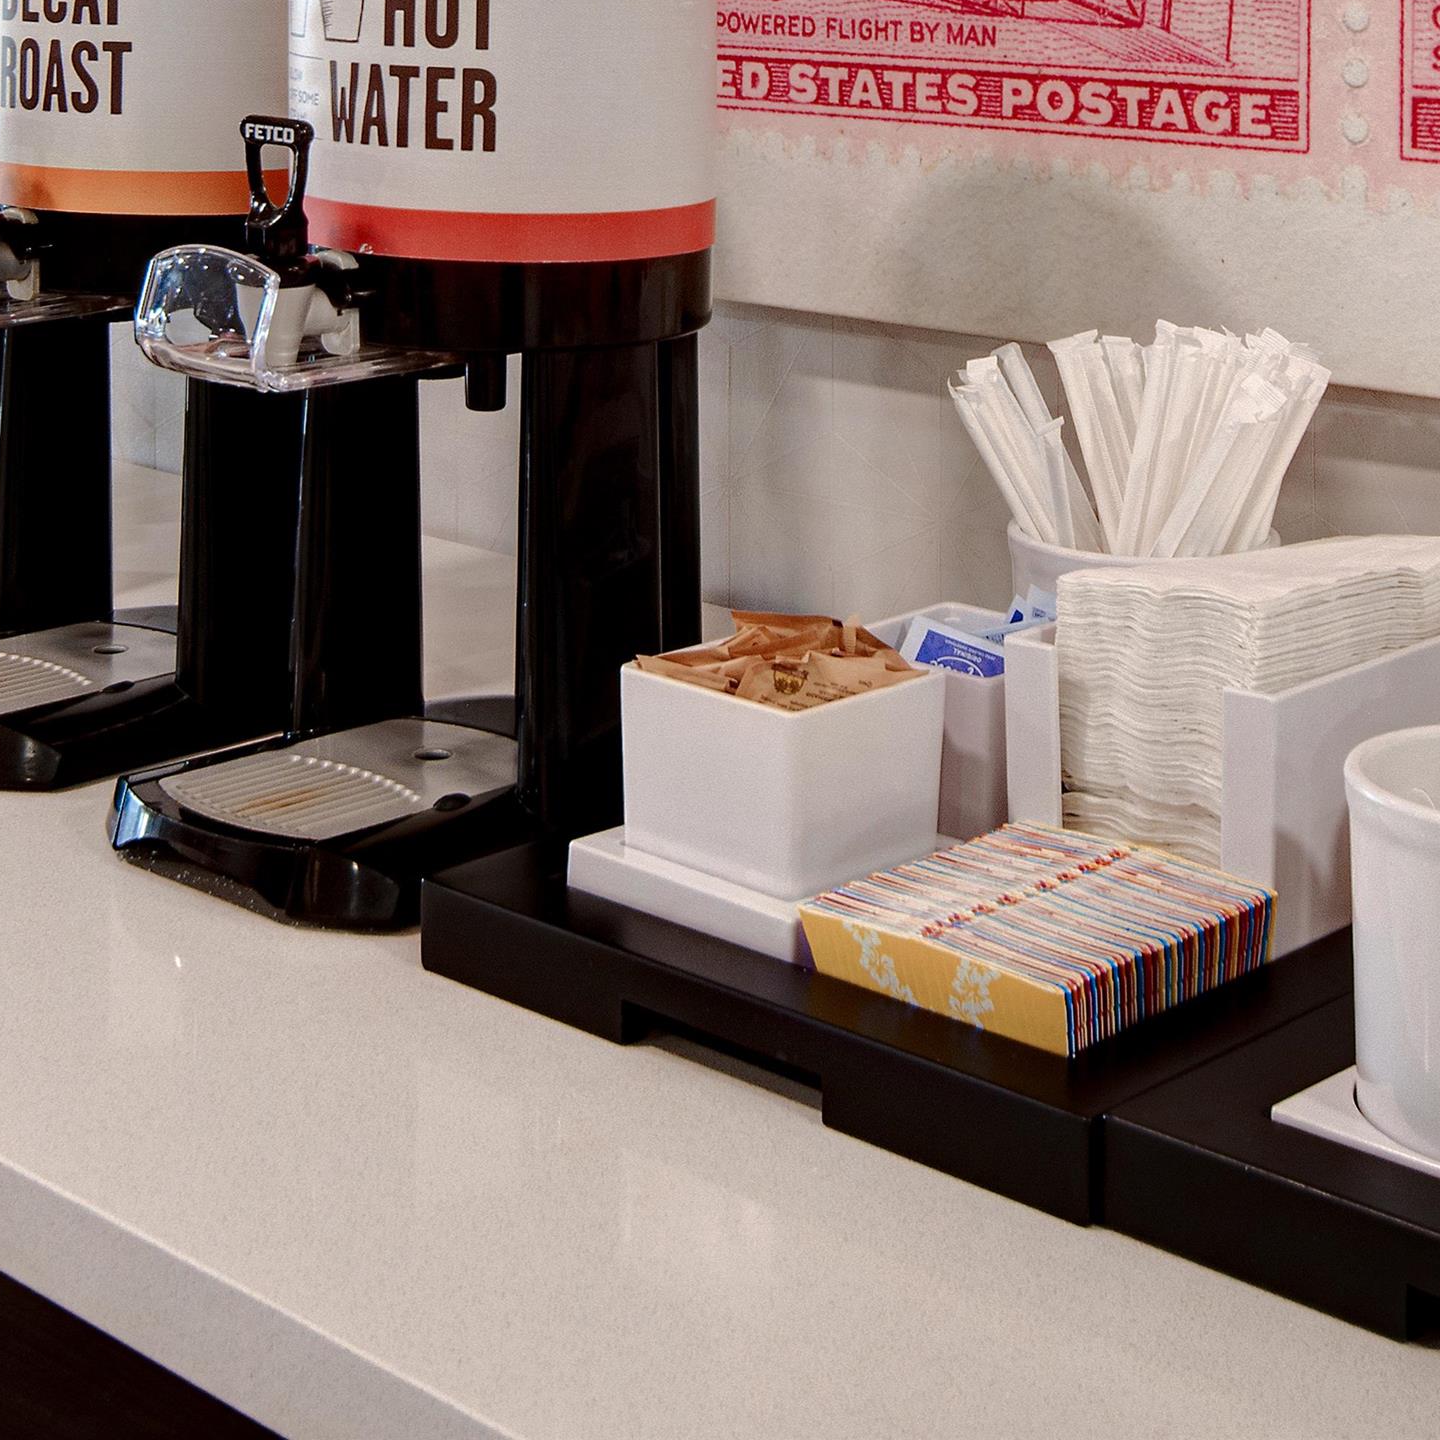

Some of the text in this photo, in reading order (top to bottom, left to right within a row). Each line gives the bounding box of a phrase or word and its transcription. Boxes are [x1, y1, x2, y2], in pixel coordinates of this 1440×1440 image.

[716, 13, 997, 47] POWERED FLIGHT BY MAN
[0, 36, 133, 115] ROAST
[328, 60, 498, 153] WATER
[788, 66, 982, 114] STATES
[1001, 79, 1272, 136] POSTAGE
[244, 123, 296, 143] FETCO
